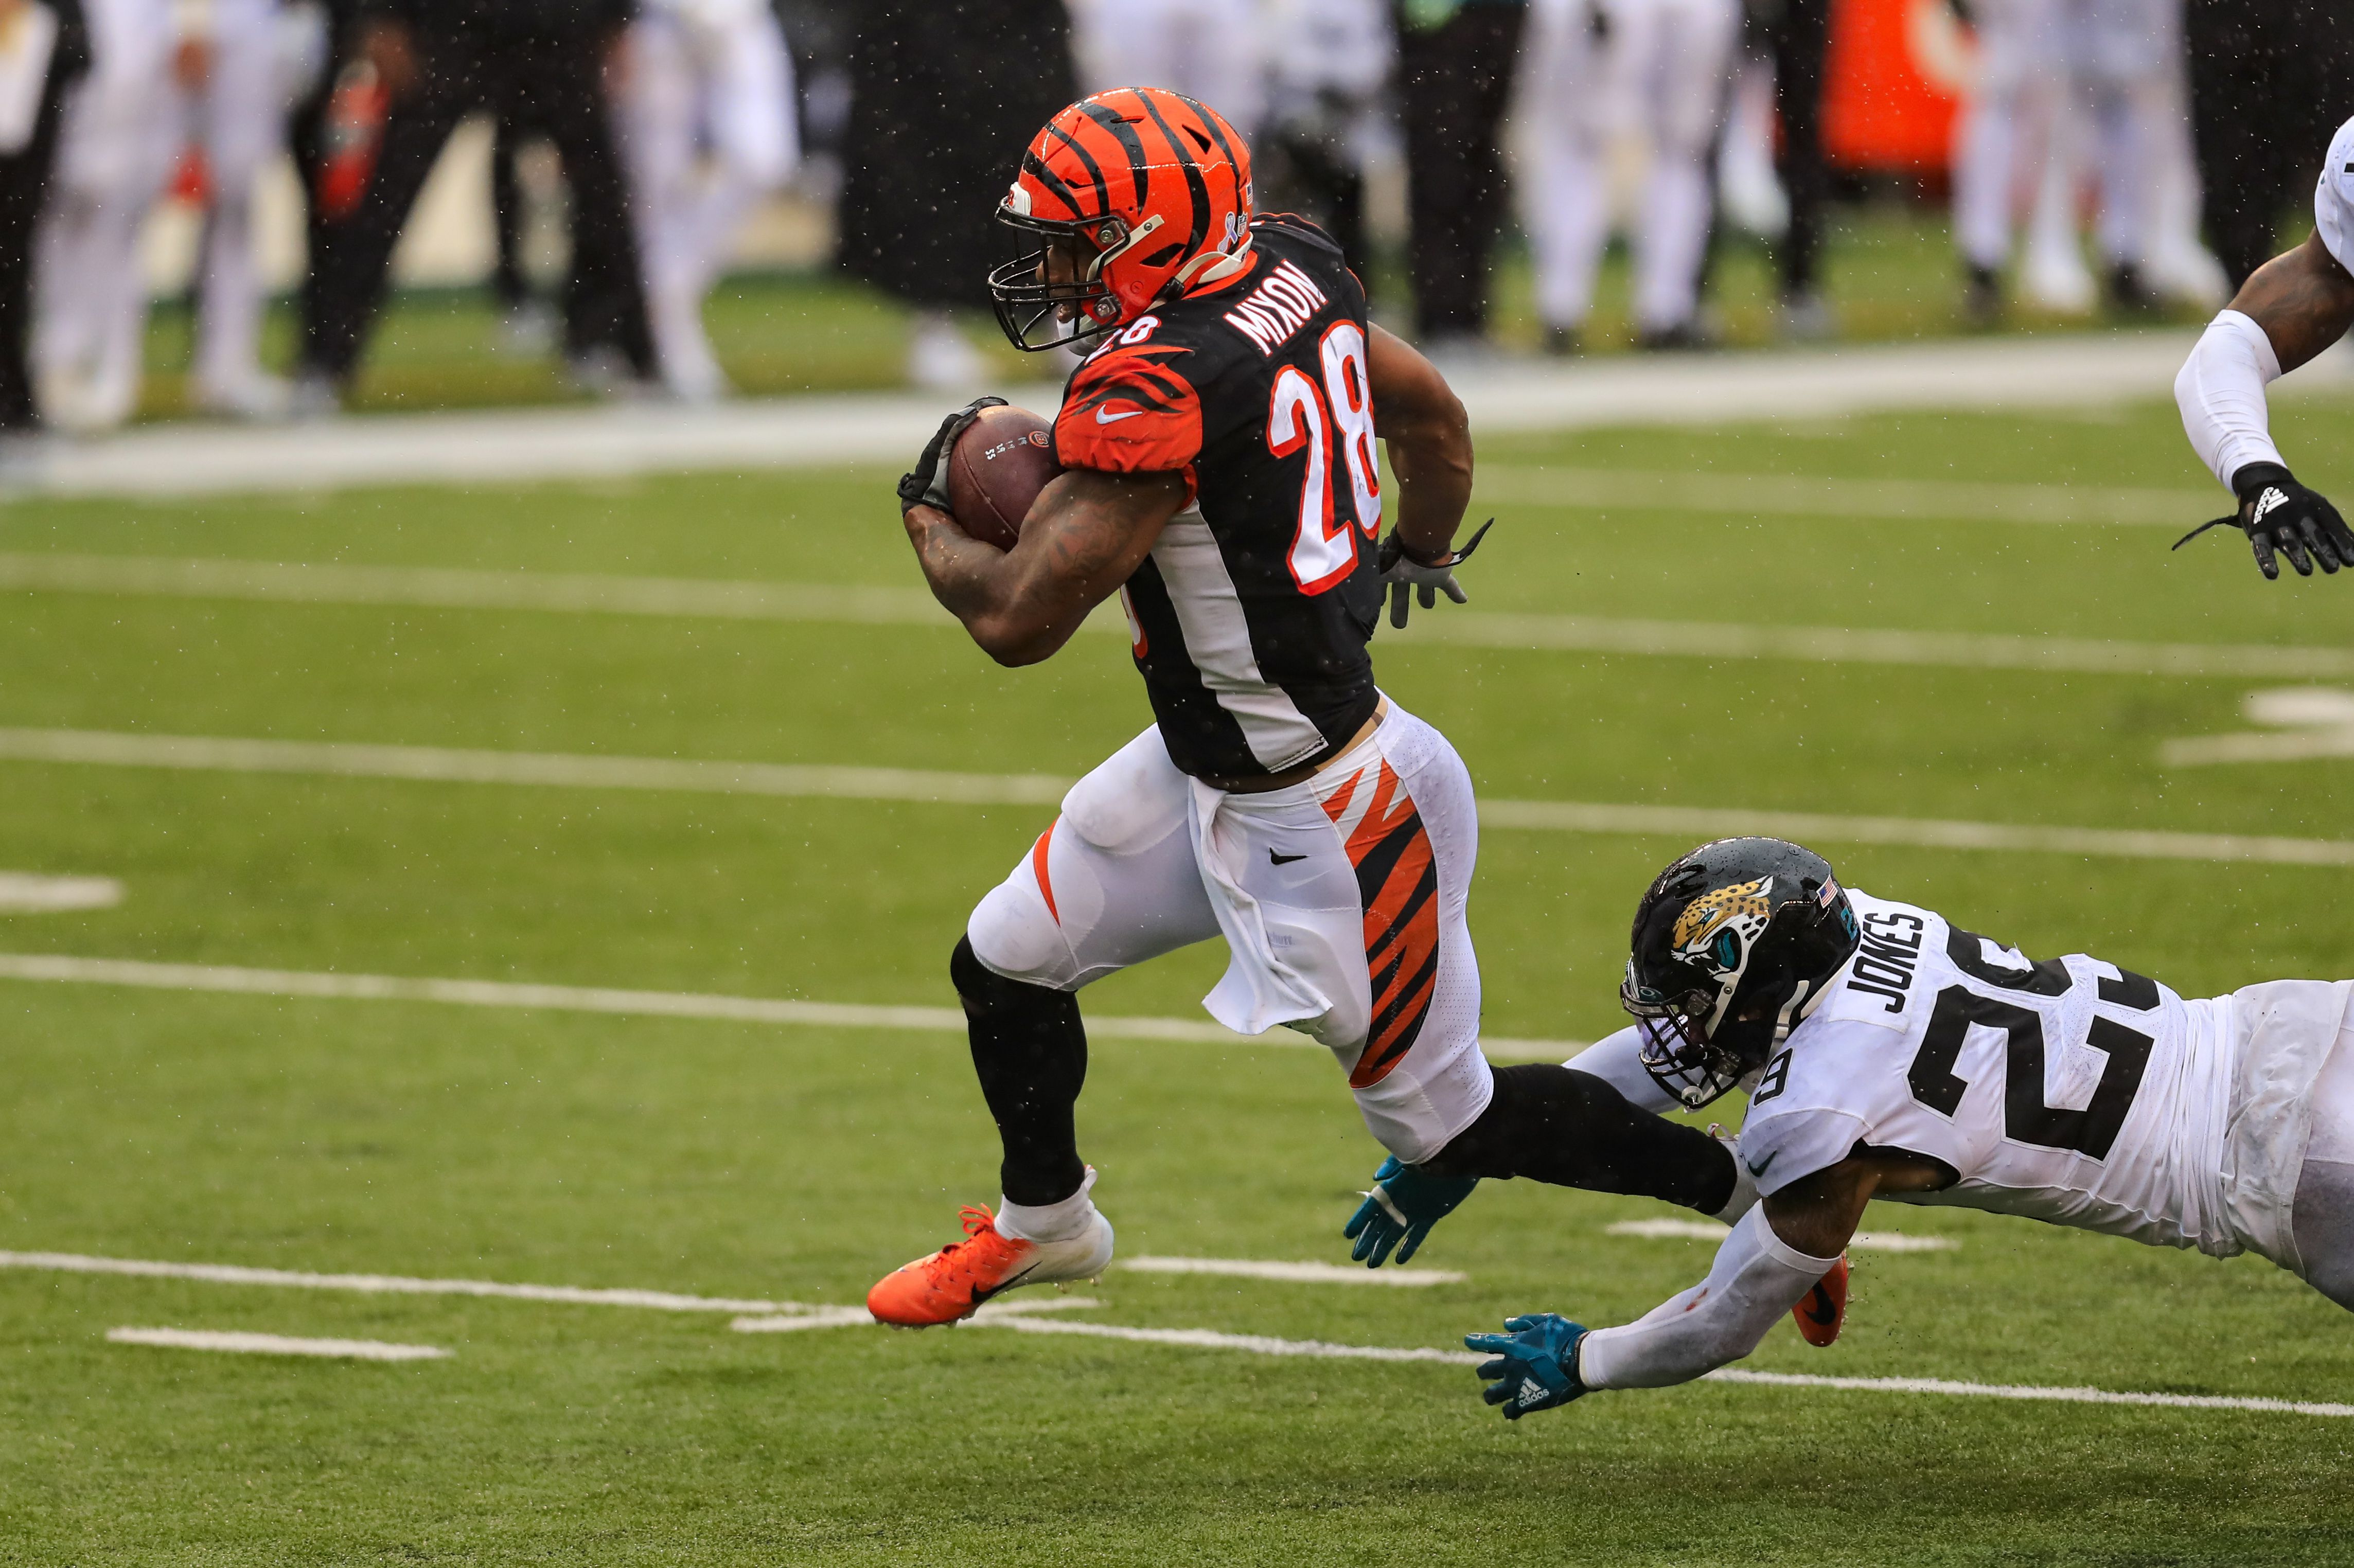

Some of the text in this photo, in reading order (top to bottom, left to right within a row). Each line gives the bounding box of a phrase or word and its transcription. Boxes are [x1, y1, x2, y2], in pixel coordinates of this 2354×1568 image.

[1084, 315, 1162, 366] 28
[1223, 258, 1328, 357] MIXON
[985, 449, 996, 460] 55
[1267, 319, 1381, 596] 28
[2253, 487, 2274, 524] adidas
[1847, 913, 1923, 1013] JONES
[1906, 922, 2161, 1163] 29
[1519, 1388, 1549, 1406] adidas
